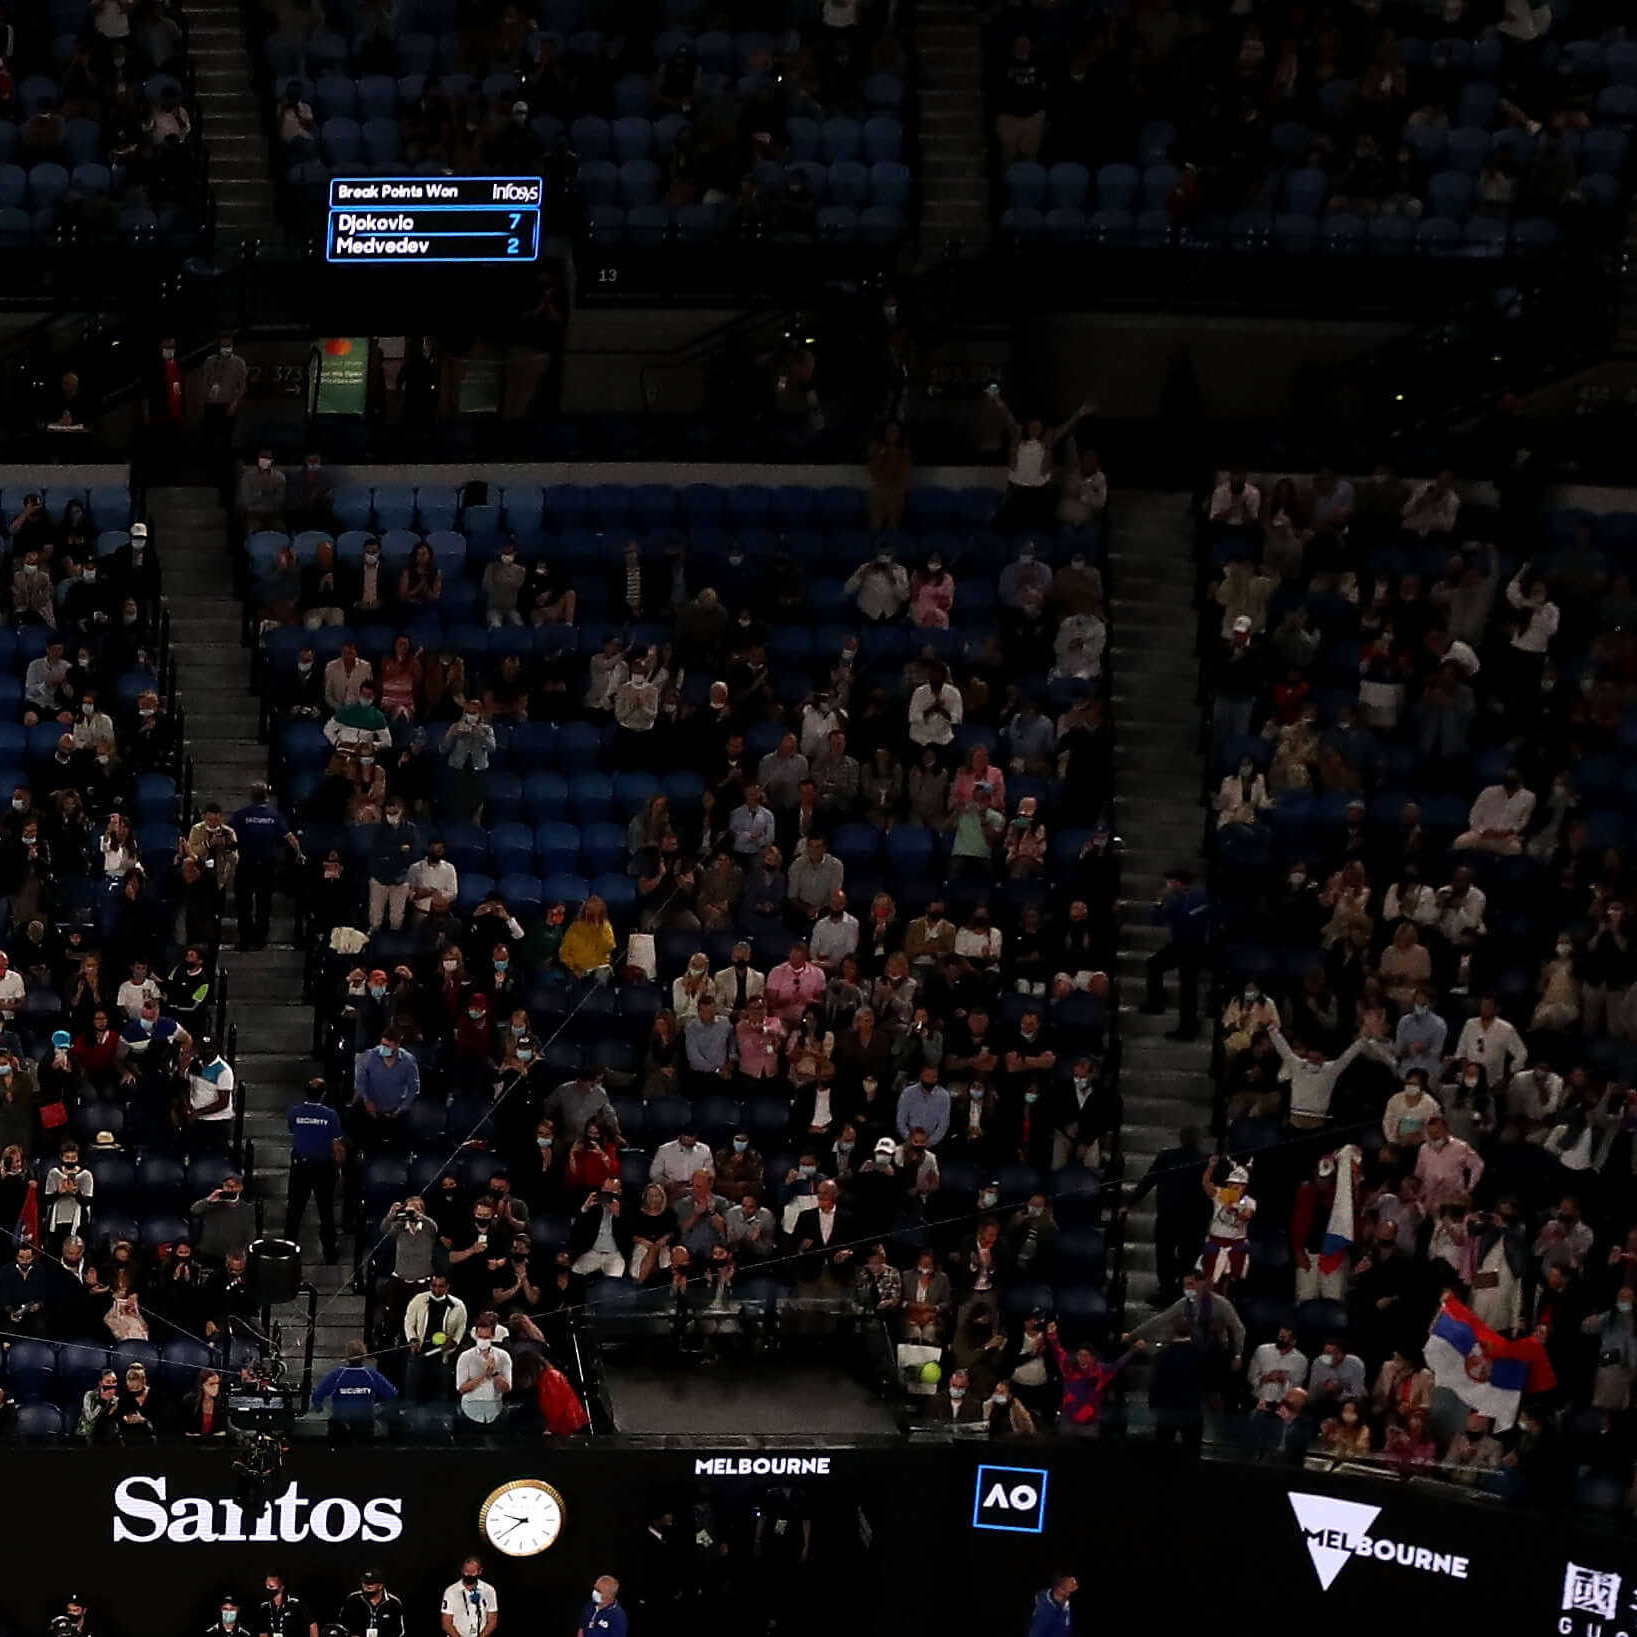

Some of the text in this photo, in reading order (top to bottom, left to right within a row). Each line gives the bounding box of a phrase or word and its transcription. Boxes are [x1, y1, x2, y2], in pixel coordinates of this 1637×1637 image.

[338, 184, 458, 198] Break Points Won
[493, 183, 538, 202] Infosys
[509, 214, 521, 229] 7
[337, 237, 519, 254] Medvedev 2
[694, 1457, 831, 1475] MELBOURNE
[982, 1483, 1039, 1512] AO
[114, 1476, 404, 1543] Santos
[1303, 1526, 1470, 1579] MELBOURNE
